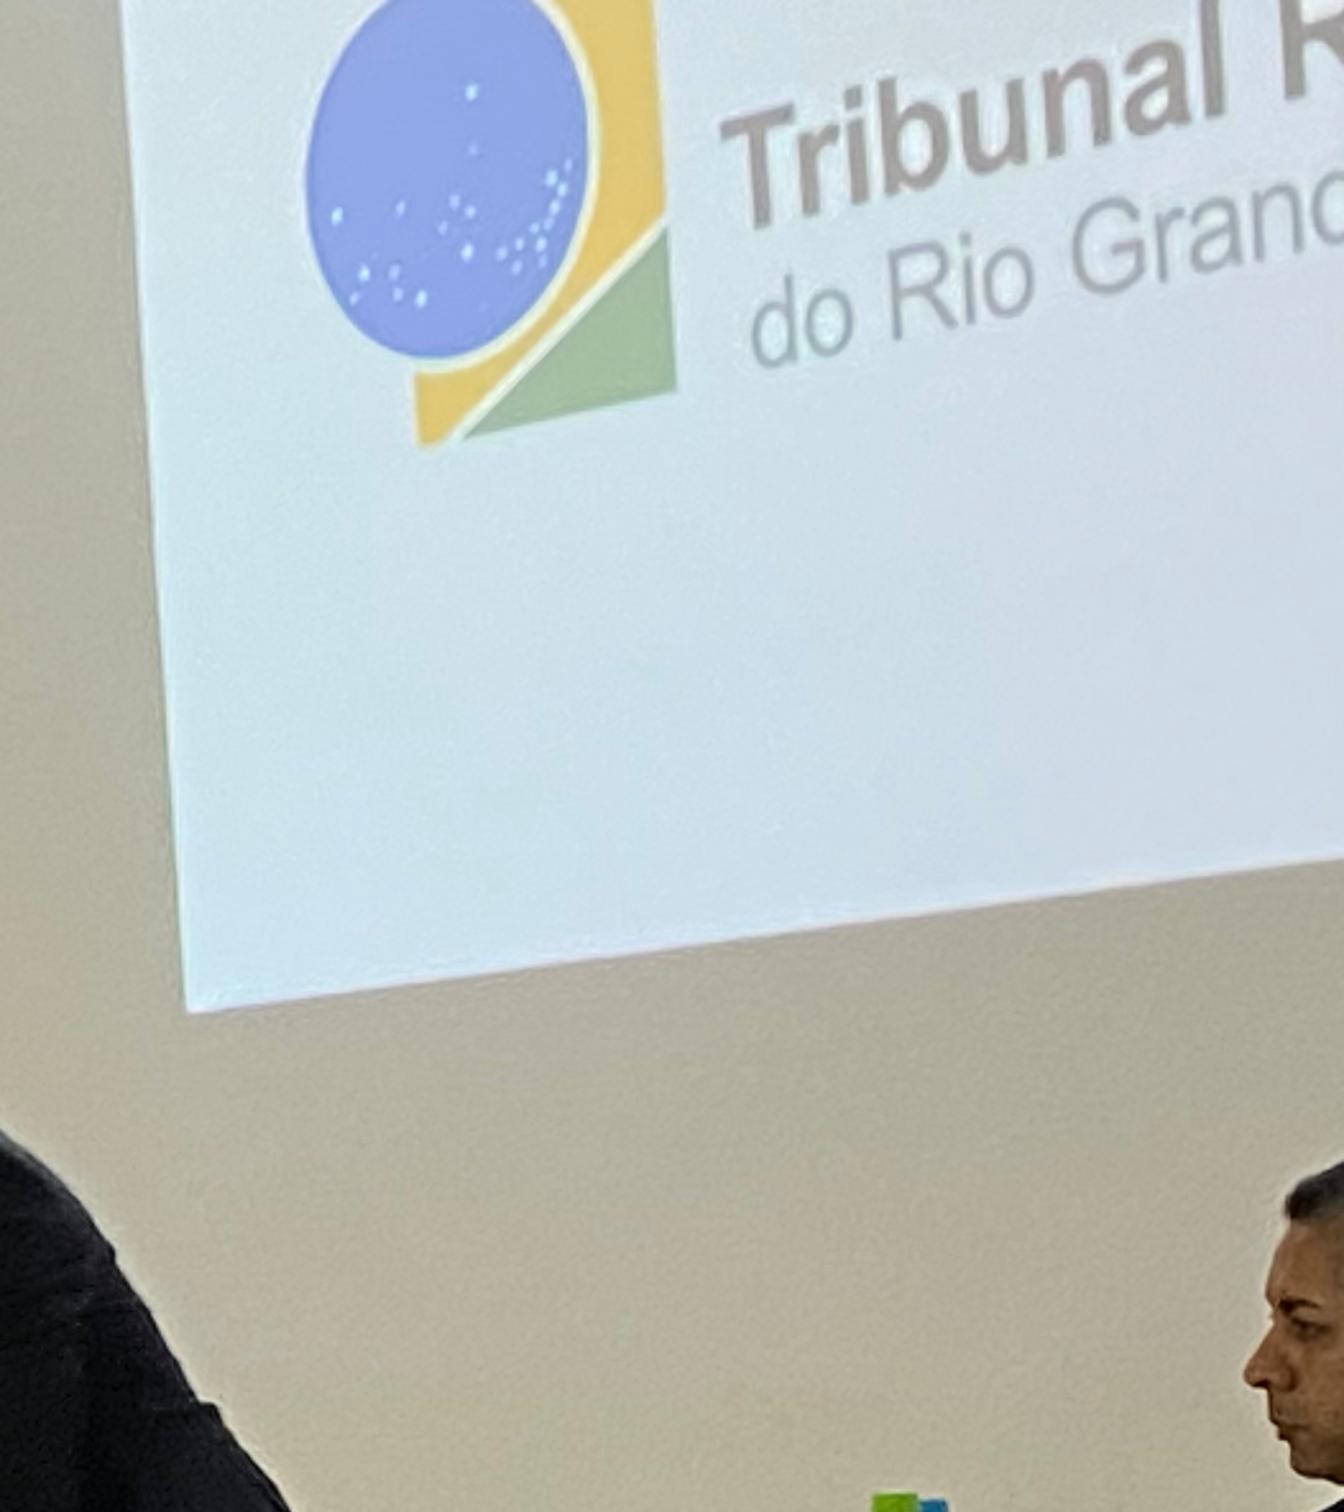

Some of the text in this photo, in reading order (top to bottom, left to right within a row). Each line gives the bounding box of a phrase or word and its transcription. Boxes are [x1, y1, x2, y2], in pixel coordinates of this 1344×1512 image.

[720, 0, 1226, 230] Tribunal
[750, 272, 856, 370] do
[887, 230, 1036, 341] Rio
